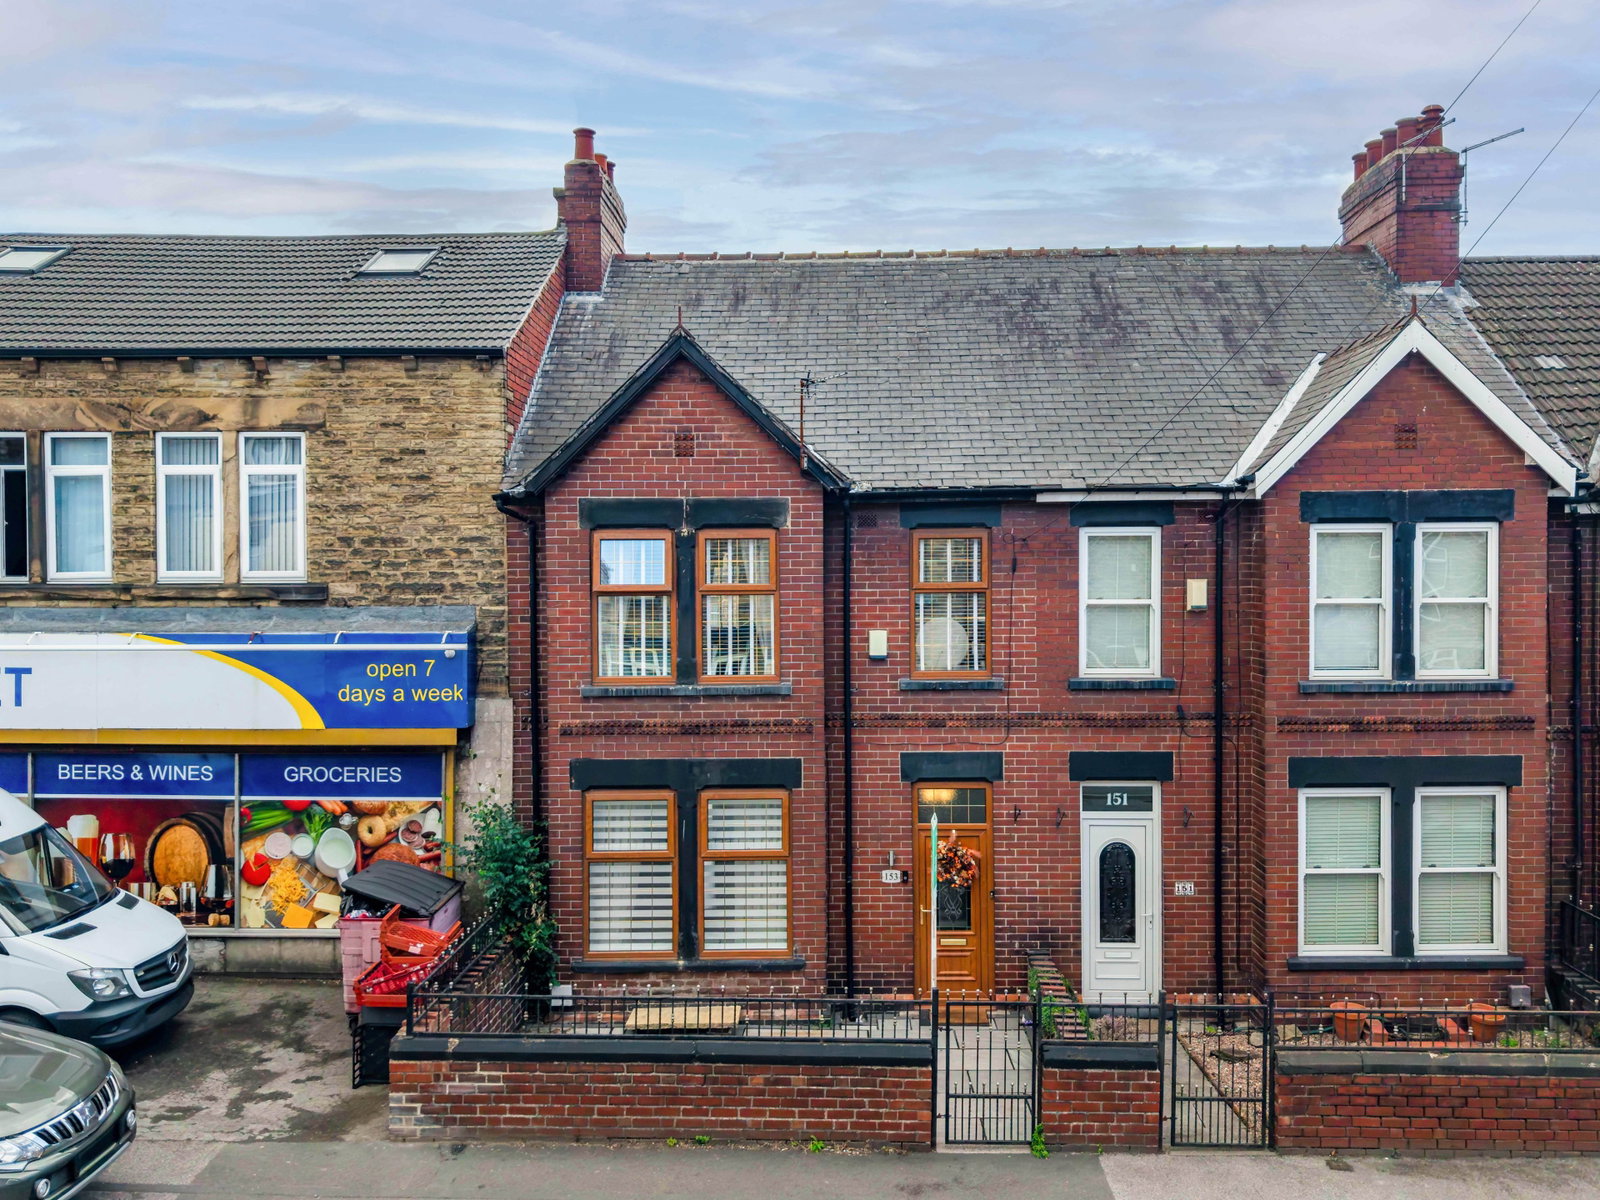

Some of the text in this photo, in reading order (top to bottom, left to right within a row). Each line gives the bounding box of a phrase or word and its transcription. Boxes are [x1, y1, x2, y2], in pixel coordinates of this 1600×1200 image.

[366, 659, 435, 681] open 7
[0, 667, 33, 707] T
[338, 683, 464, 706] days a week
[57, 763, 214, 782] BEERS & WINES
[283, 766, 402, 783] GROCERIES
[1106, 792, 1128, 806] 151
[885, 872, 899, 881] 153
